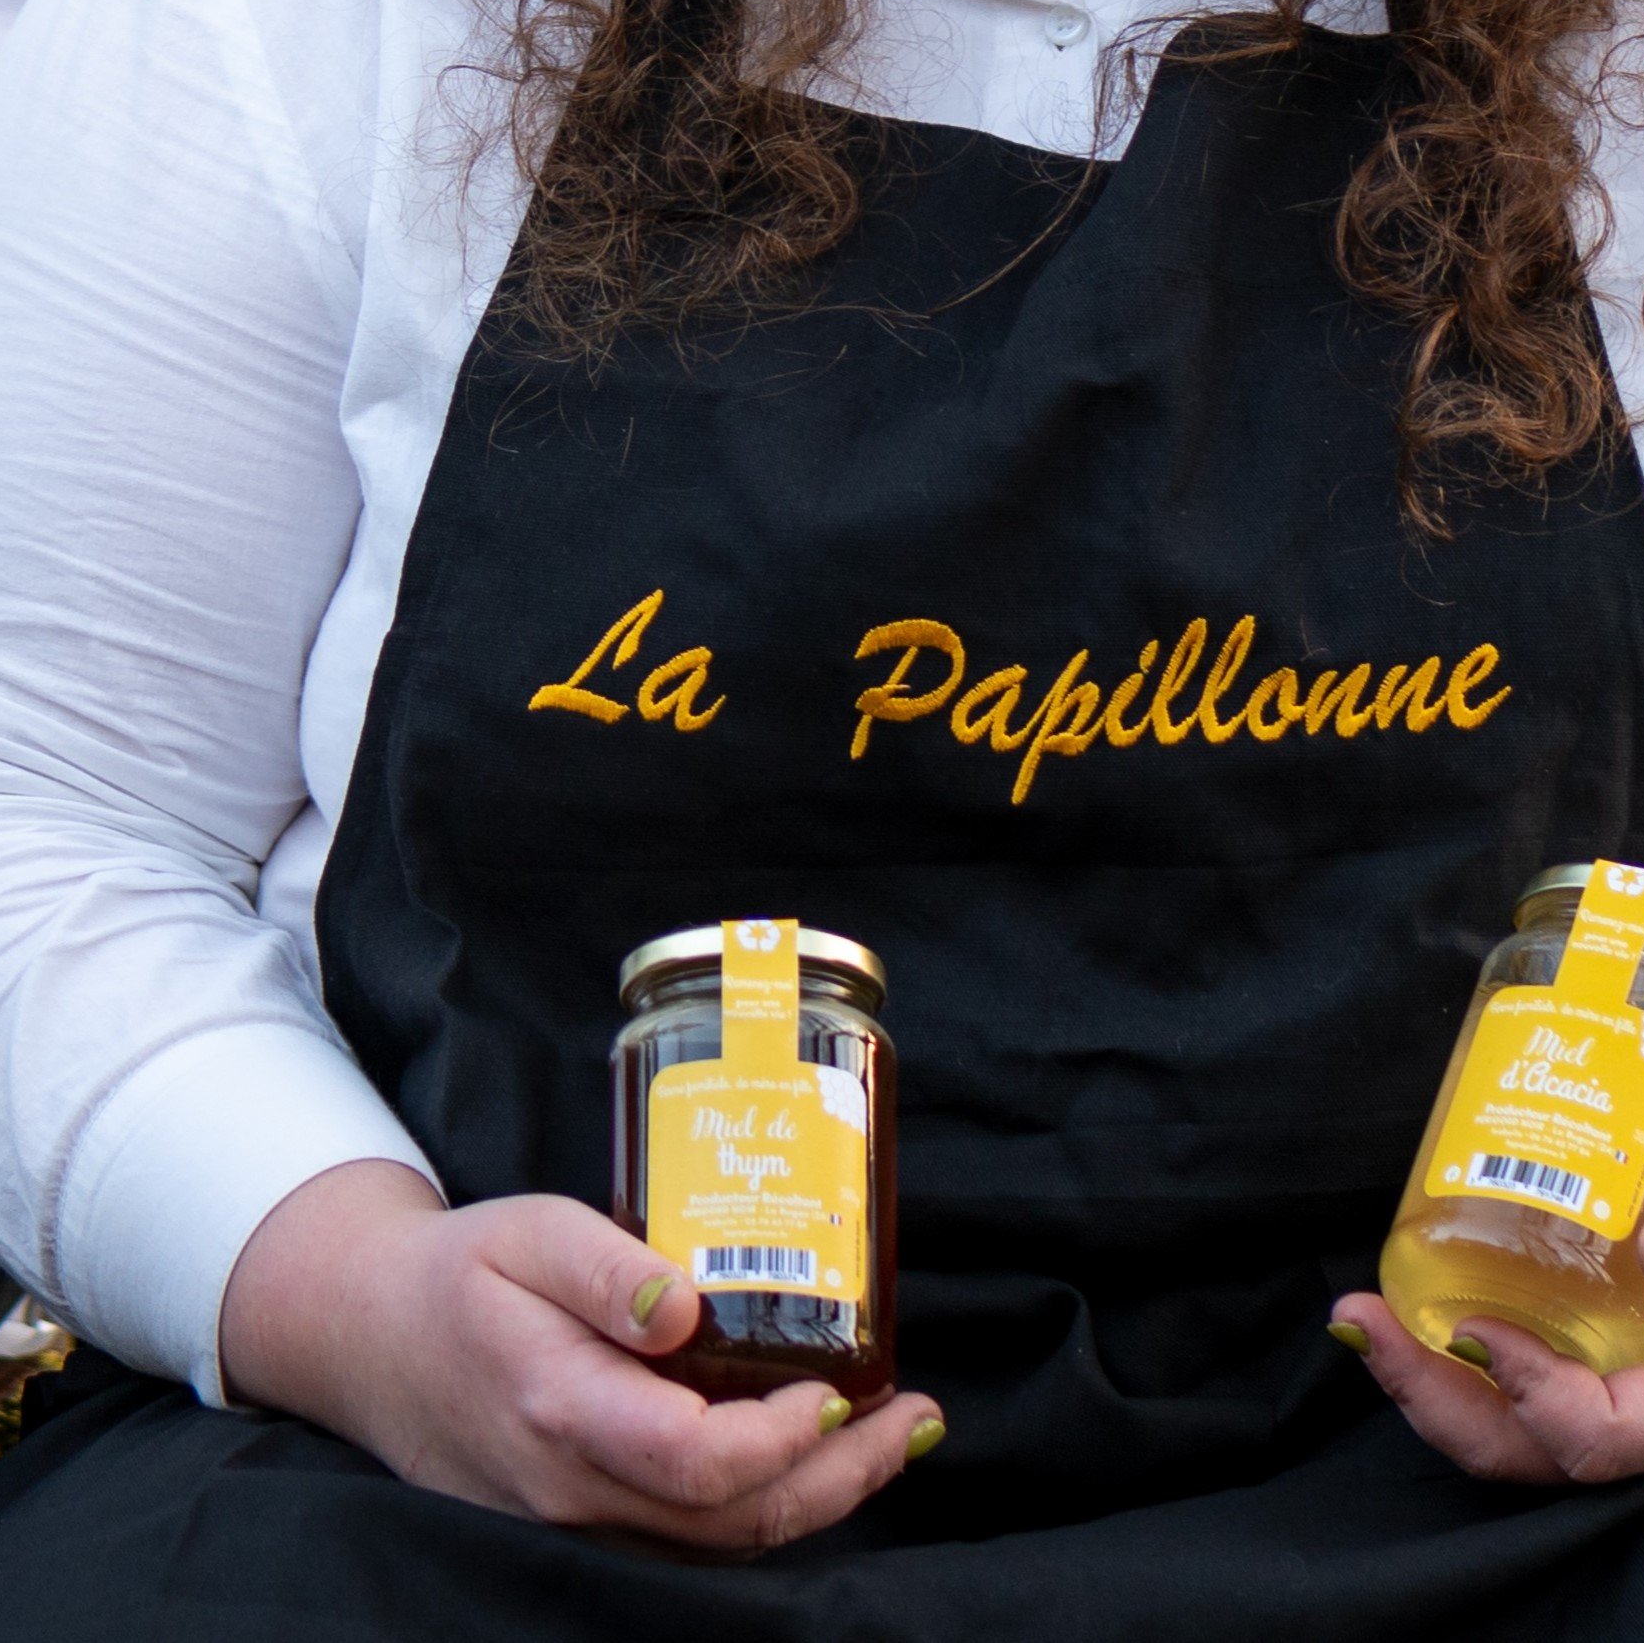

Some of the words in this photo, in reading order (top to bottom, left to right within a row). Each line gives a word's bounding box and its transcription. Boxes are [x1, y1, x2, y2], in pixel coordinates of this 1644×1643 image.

[527, 587, 726, 733] La
[849, 613, 1514, 805] Papillonne
[1524, 1025, 1595, 1067] Miel
[1499, 1059, 1613, 1114] d'Acacia
[690, 1105, 758, 1140] Miel
[767, 1108, 797, 1140] de
[717, 1142, 792, 1191] thym
